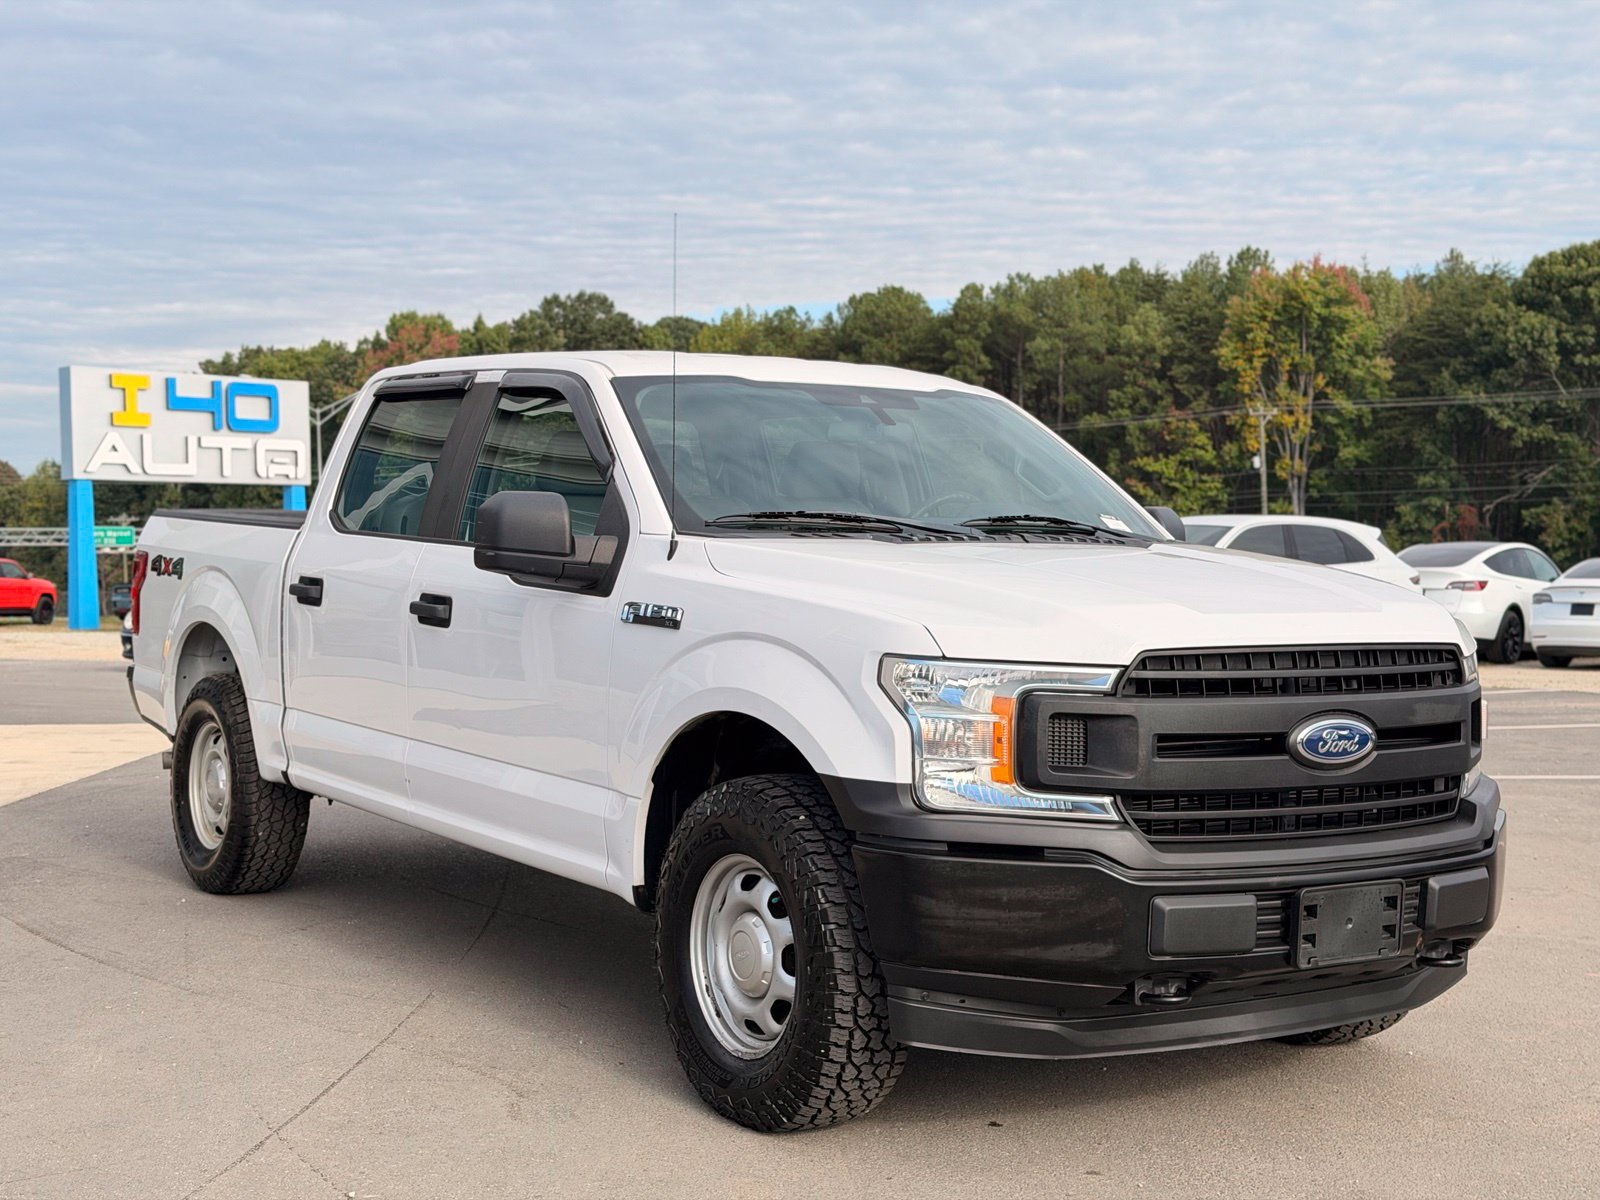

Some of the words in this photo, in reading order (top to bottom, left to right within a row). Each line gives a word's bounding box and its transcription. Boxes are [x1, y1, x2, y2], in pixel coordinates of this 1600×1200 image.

[110, 373, 151, 427] I
[166, 377, 279, 433] 40
[1318, 729, 1360, 753] Ford
